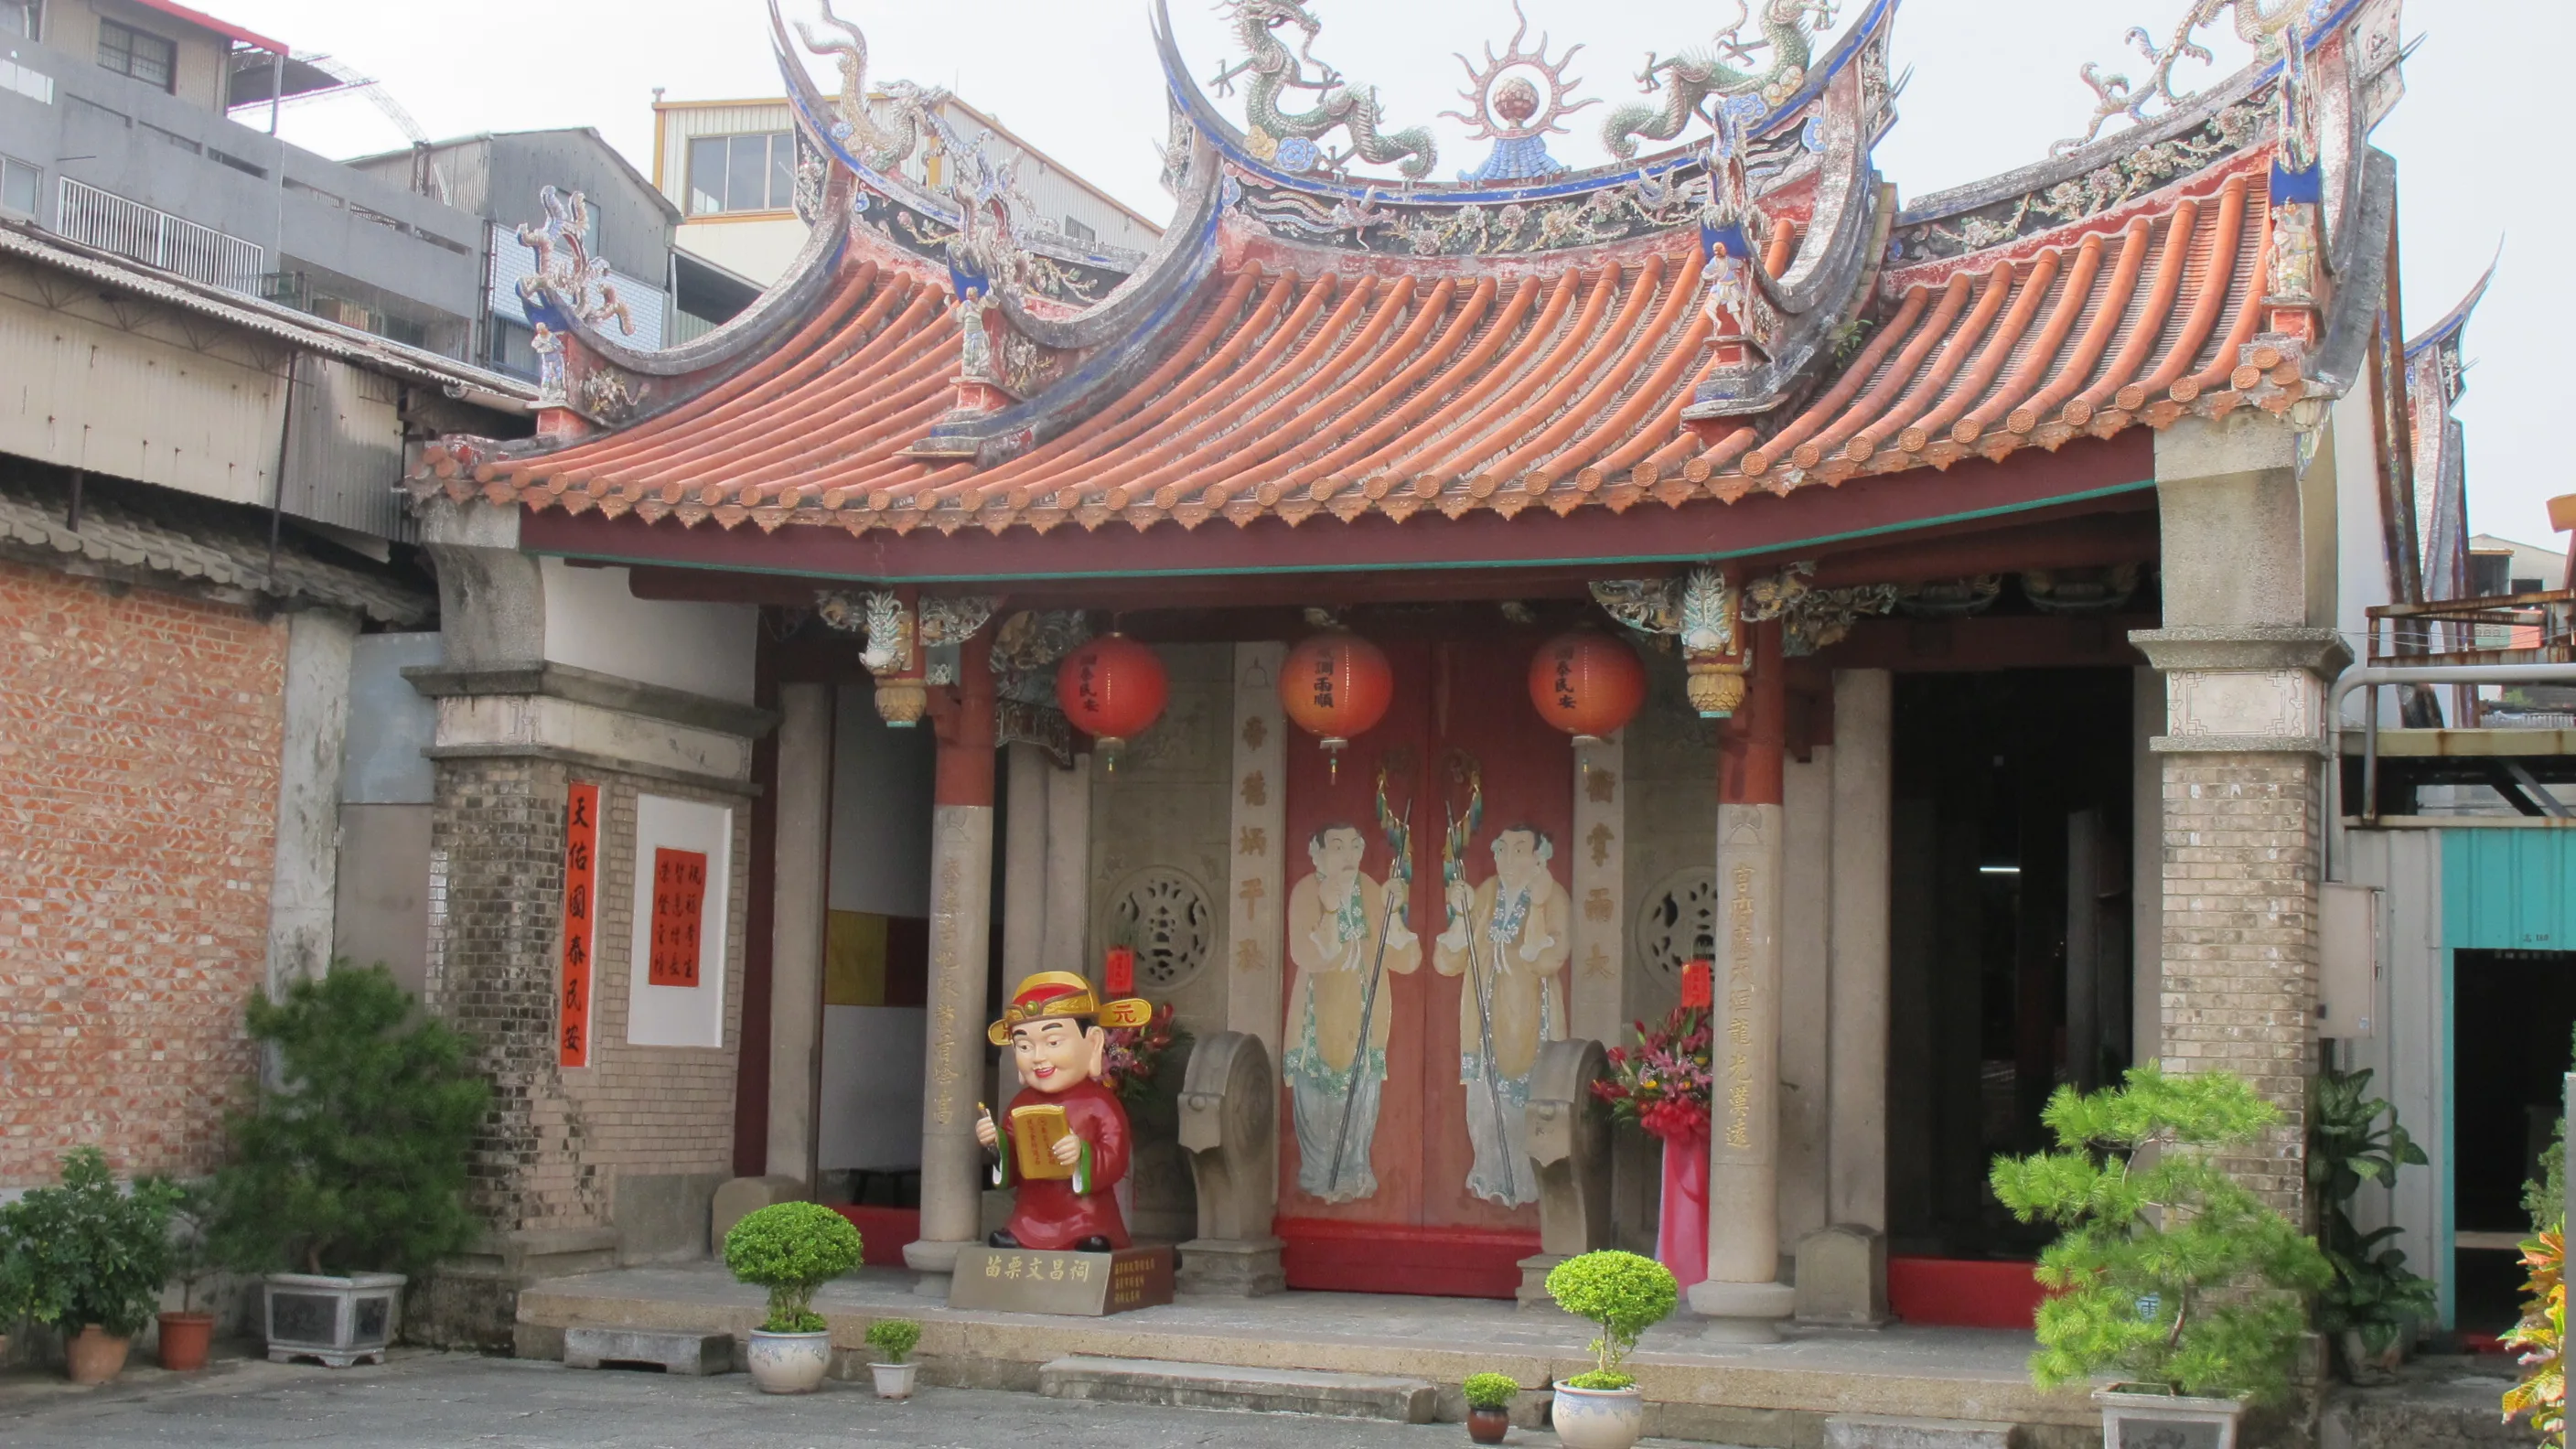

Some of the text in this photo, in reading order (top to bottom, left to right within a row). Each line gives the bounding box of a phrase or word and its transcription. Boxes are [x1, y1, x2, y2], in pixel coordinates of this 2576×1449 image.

[564, 795, 590, 1054] 天佑國泰民安
[1112, 1004, 1138, 1025] 元
[984, 1254, 1090, 1283] 苗栗文昌祠
